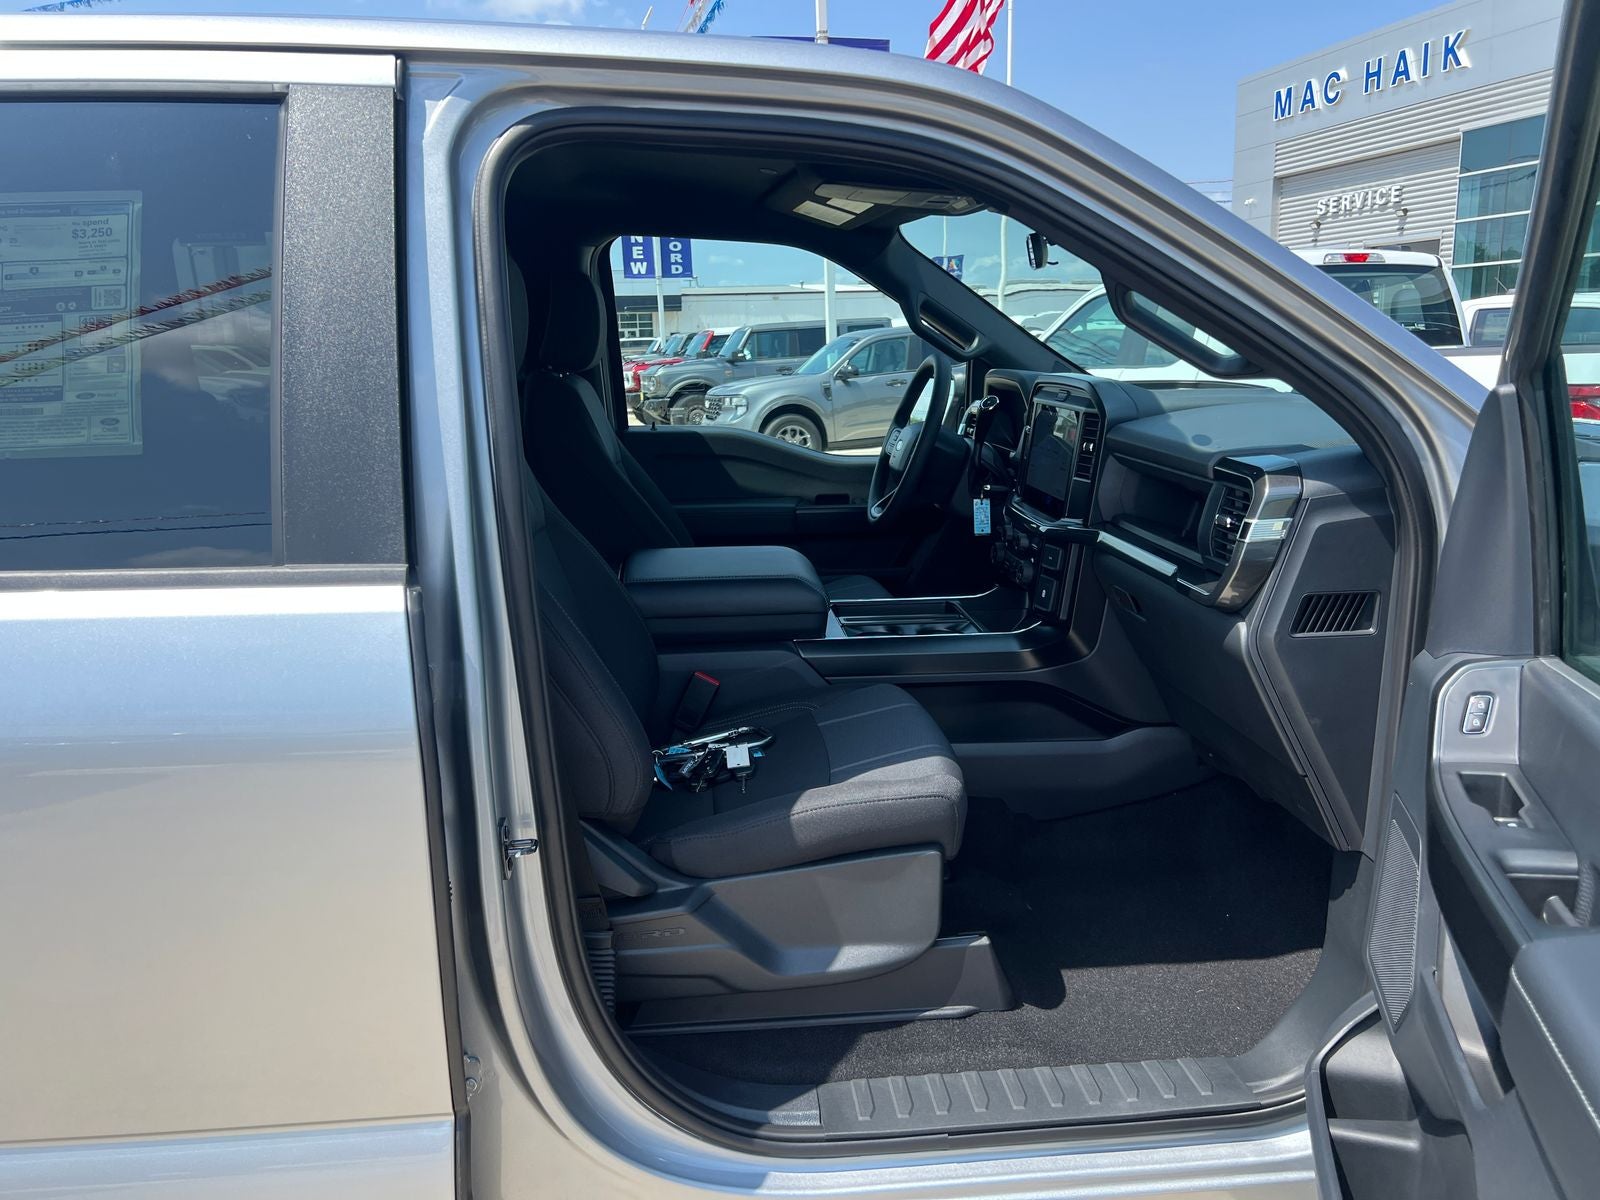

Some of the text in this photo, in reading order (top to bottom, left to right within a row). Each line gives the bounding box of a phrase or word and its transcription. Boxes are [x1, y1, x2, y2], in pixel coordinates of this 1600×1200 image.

[1273, 29, 1469, 122] MAC HAIK
[1316, 185, 1402, 216] SERVICE
[71, 226, 112, 240] $3,250
[668, 238, 683, 274] ORD
